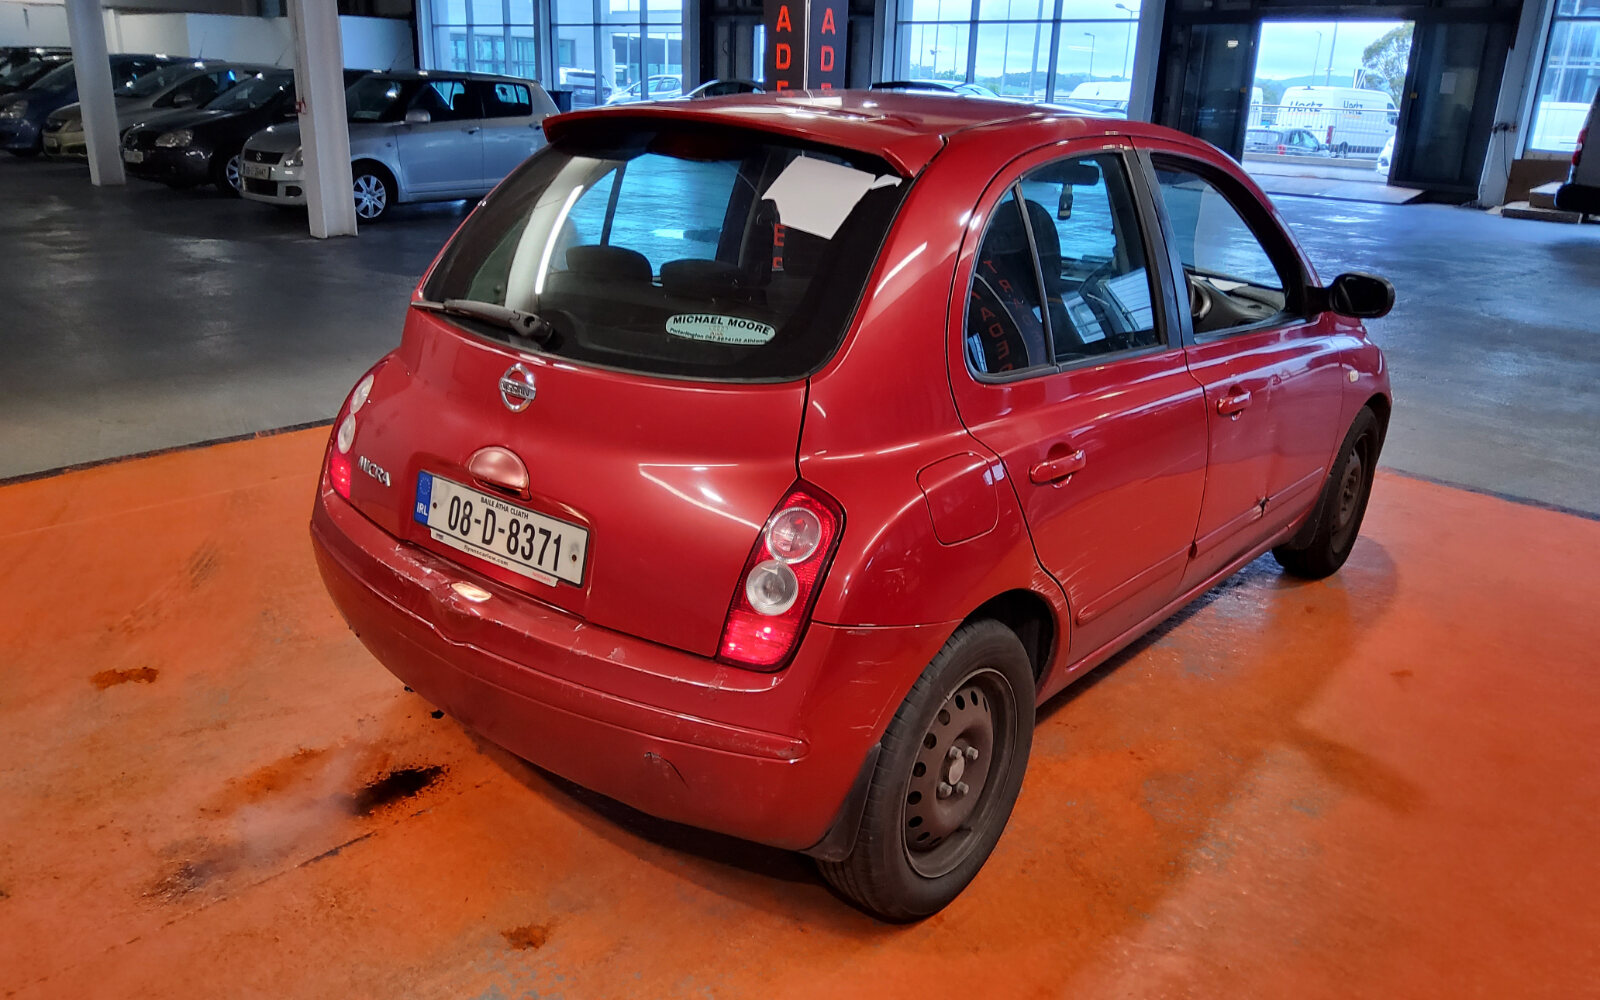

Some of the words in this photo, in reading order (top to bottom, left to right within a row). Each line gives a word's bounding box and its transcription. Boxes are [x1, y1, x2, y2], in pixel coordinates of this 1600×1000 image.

[1288, 101, 1323, 113] Hertz
[1343, 100, 1363, 115] Hertz
[673, 315, 723, 325] MICHAEL
[728, 317, 770, 335] MOORE
[358, 455, 391, 487] MICRA
[416, 502, 428, 516] IRL
[481, 497, 495, 508] BAILE
[510, 507, 529, 520] CLIATH
[448, 496, 562, 572] 08-D-8371
